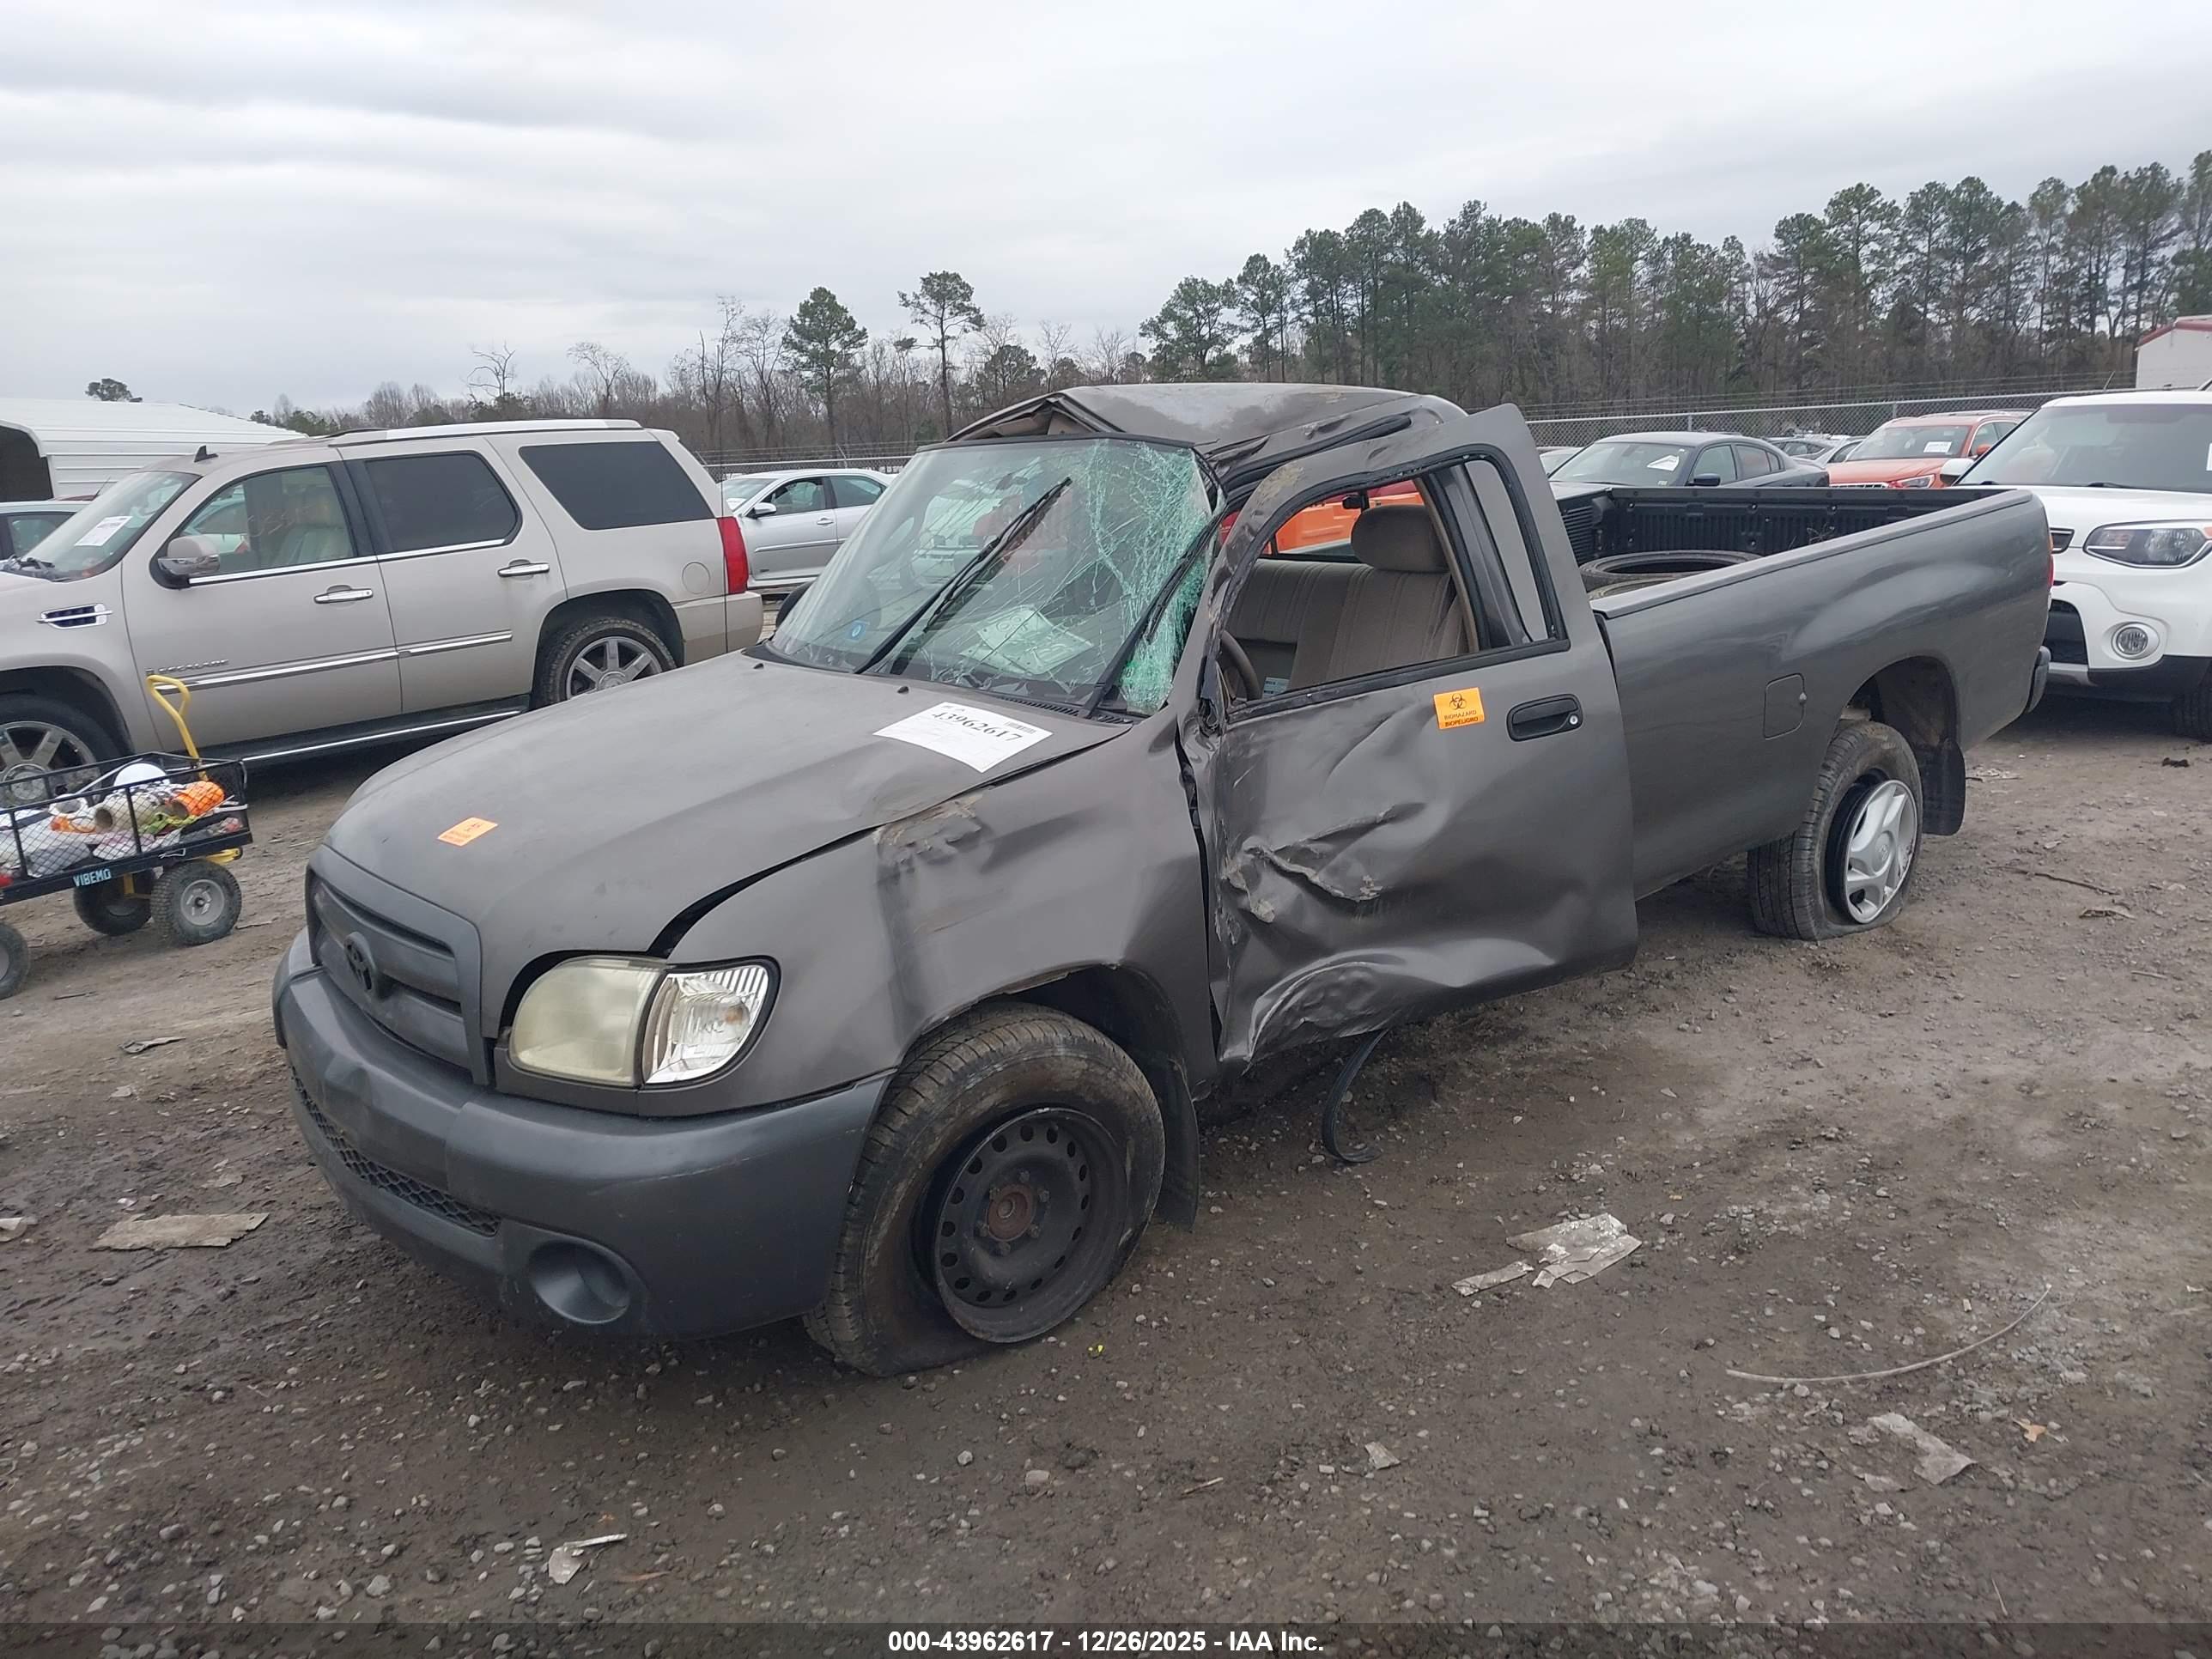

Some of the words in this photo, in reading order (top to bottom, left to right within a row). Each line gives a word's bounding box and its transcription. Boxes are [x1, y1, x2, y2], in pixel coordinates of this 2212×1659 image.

[1443, 709, 1477, 720] BIOHAZARD
[931, 711, 1024, 742] 43962617
[72, 868, 112, 887] VIBEMO
